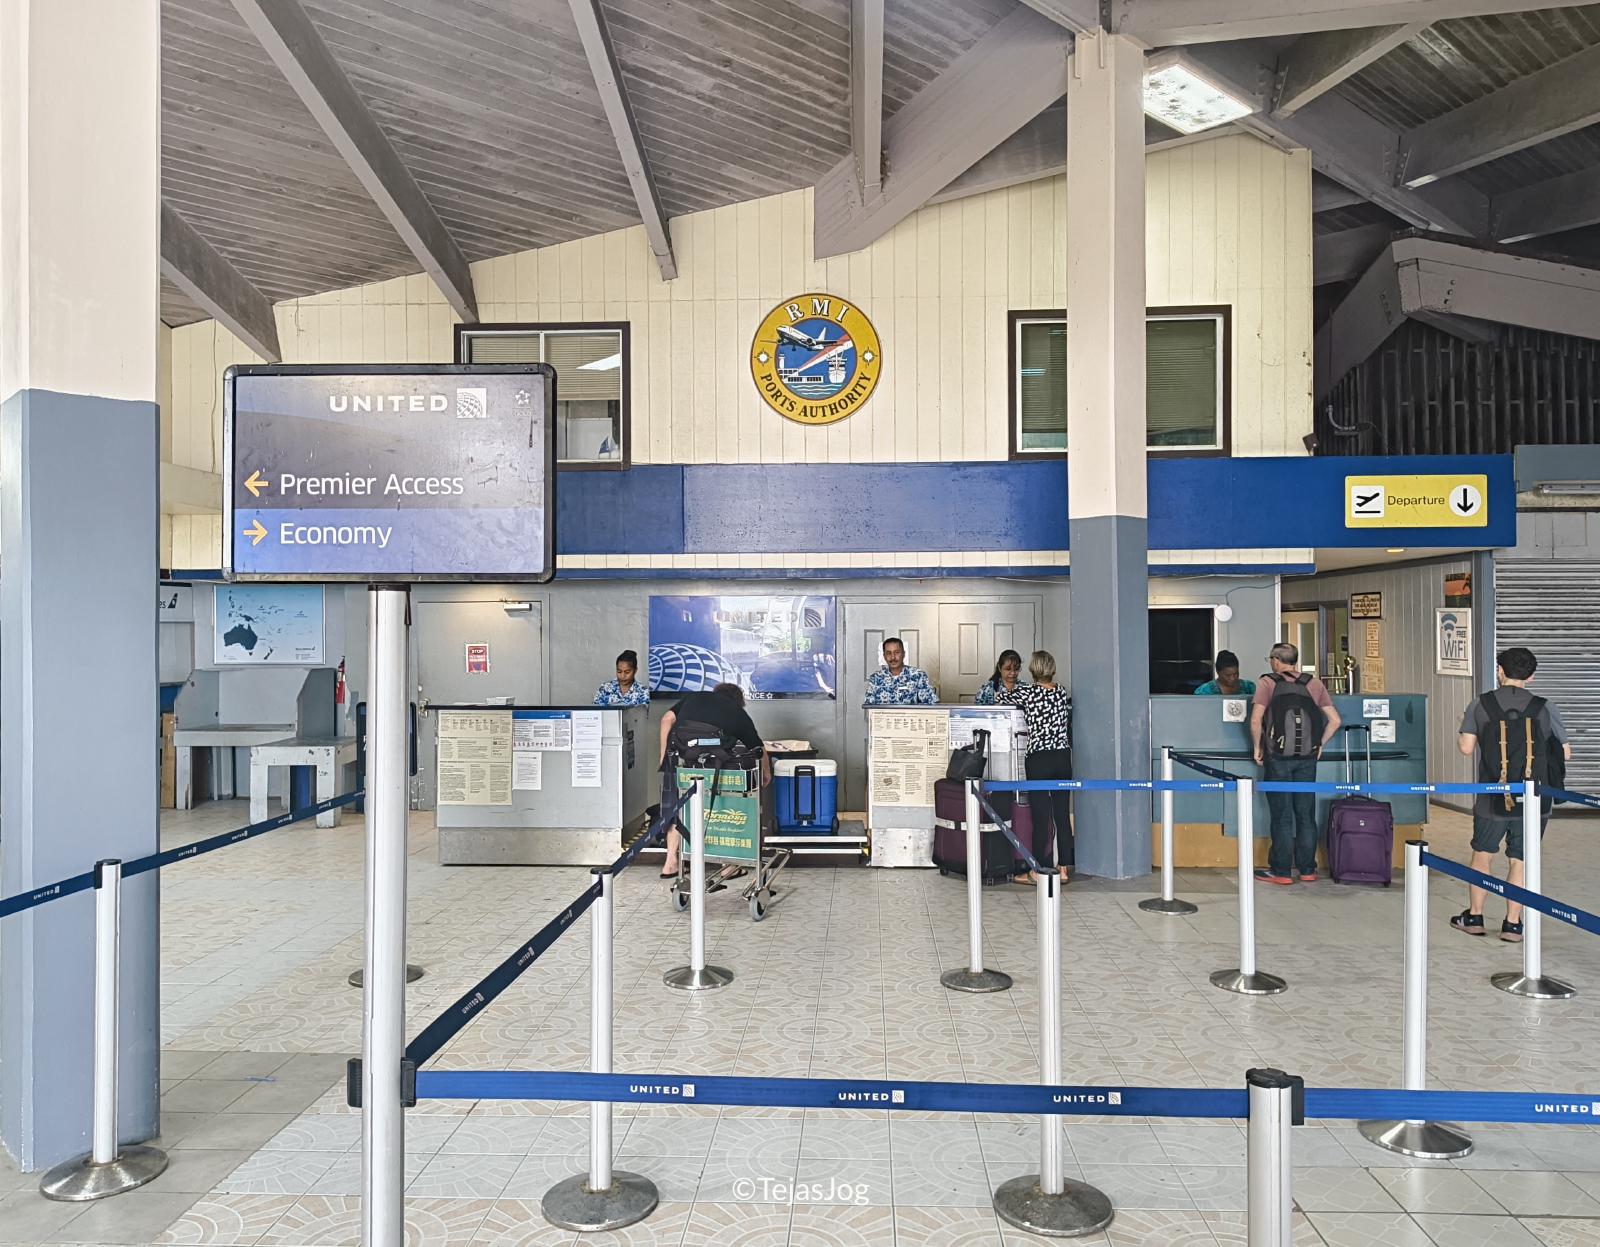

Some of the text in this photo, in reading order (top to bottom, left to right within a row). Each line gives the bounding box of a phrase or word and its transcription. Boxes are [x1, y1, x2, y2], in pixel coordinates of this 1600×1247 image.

[760, 372, 871, 418] PORTS AUTHORITY
[328, 394, 449, 412] UNITED
[280, 472, 464, 495] Premier Access
[1387, 495, 1445, 507] Departure
[280, 522, 392, 548] Economy
[1443, 640, 1467, 658] WiFi
[1482, 879, 1499, 891] UNITED
[33, 889, 55, 900] UNITED
[1551, 907, 1571, 919] UNITED
[630, 1085, 680, 1095] UNITED
[838, 1092, 890, 1102] UNITED
[1053, 1094, 1105, 1103] UNITED
[1534, 1104, 1589, 1113] UNITED
